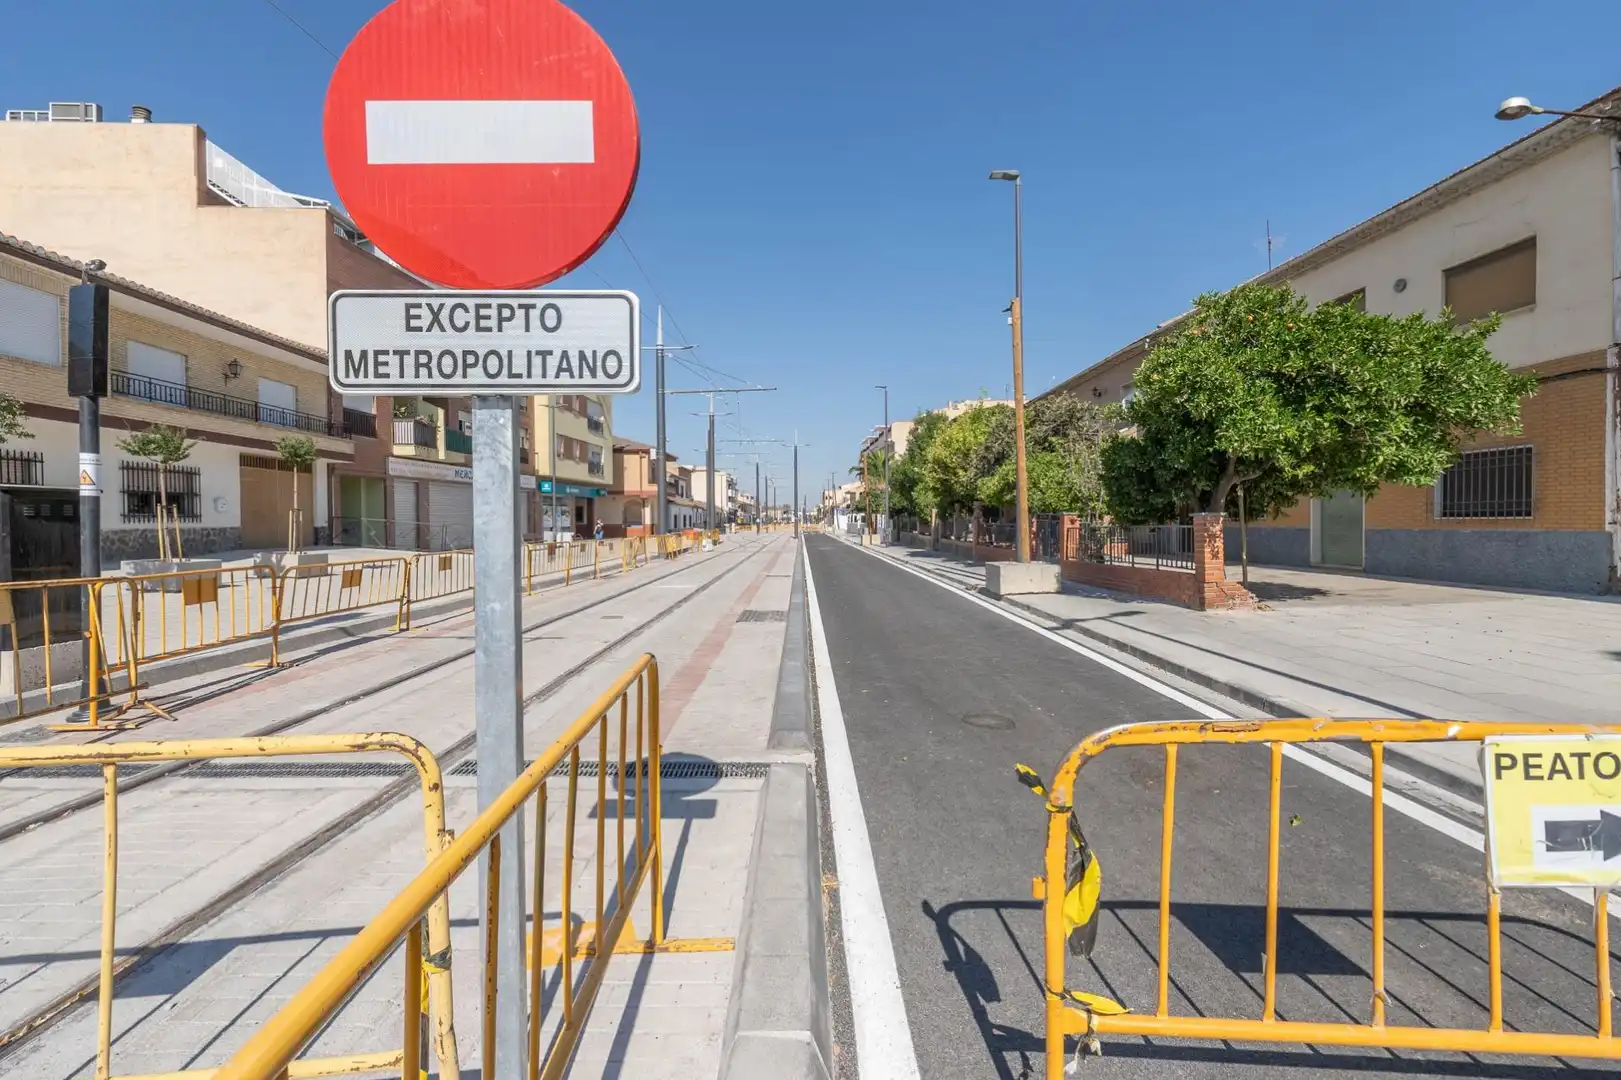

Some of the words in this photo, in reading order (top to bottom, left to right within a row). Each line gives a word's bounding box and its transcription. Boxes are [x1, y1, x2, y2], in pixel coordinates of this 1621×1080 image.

[404, 302, 562, 333] EXCEPTO
[344, 349, 623, 380] METROPOLITANO
[1494, 752, 1621, 781] PEATO
